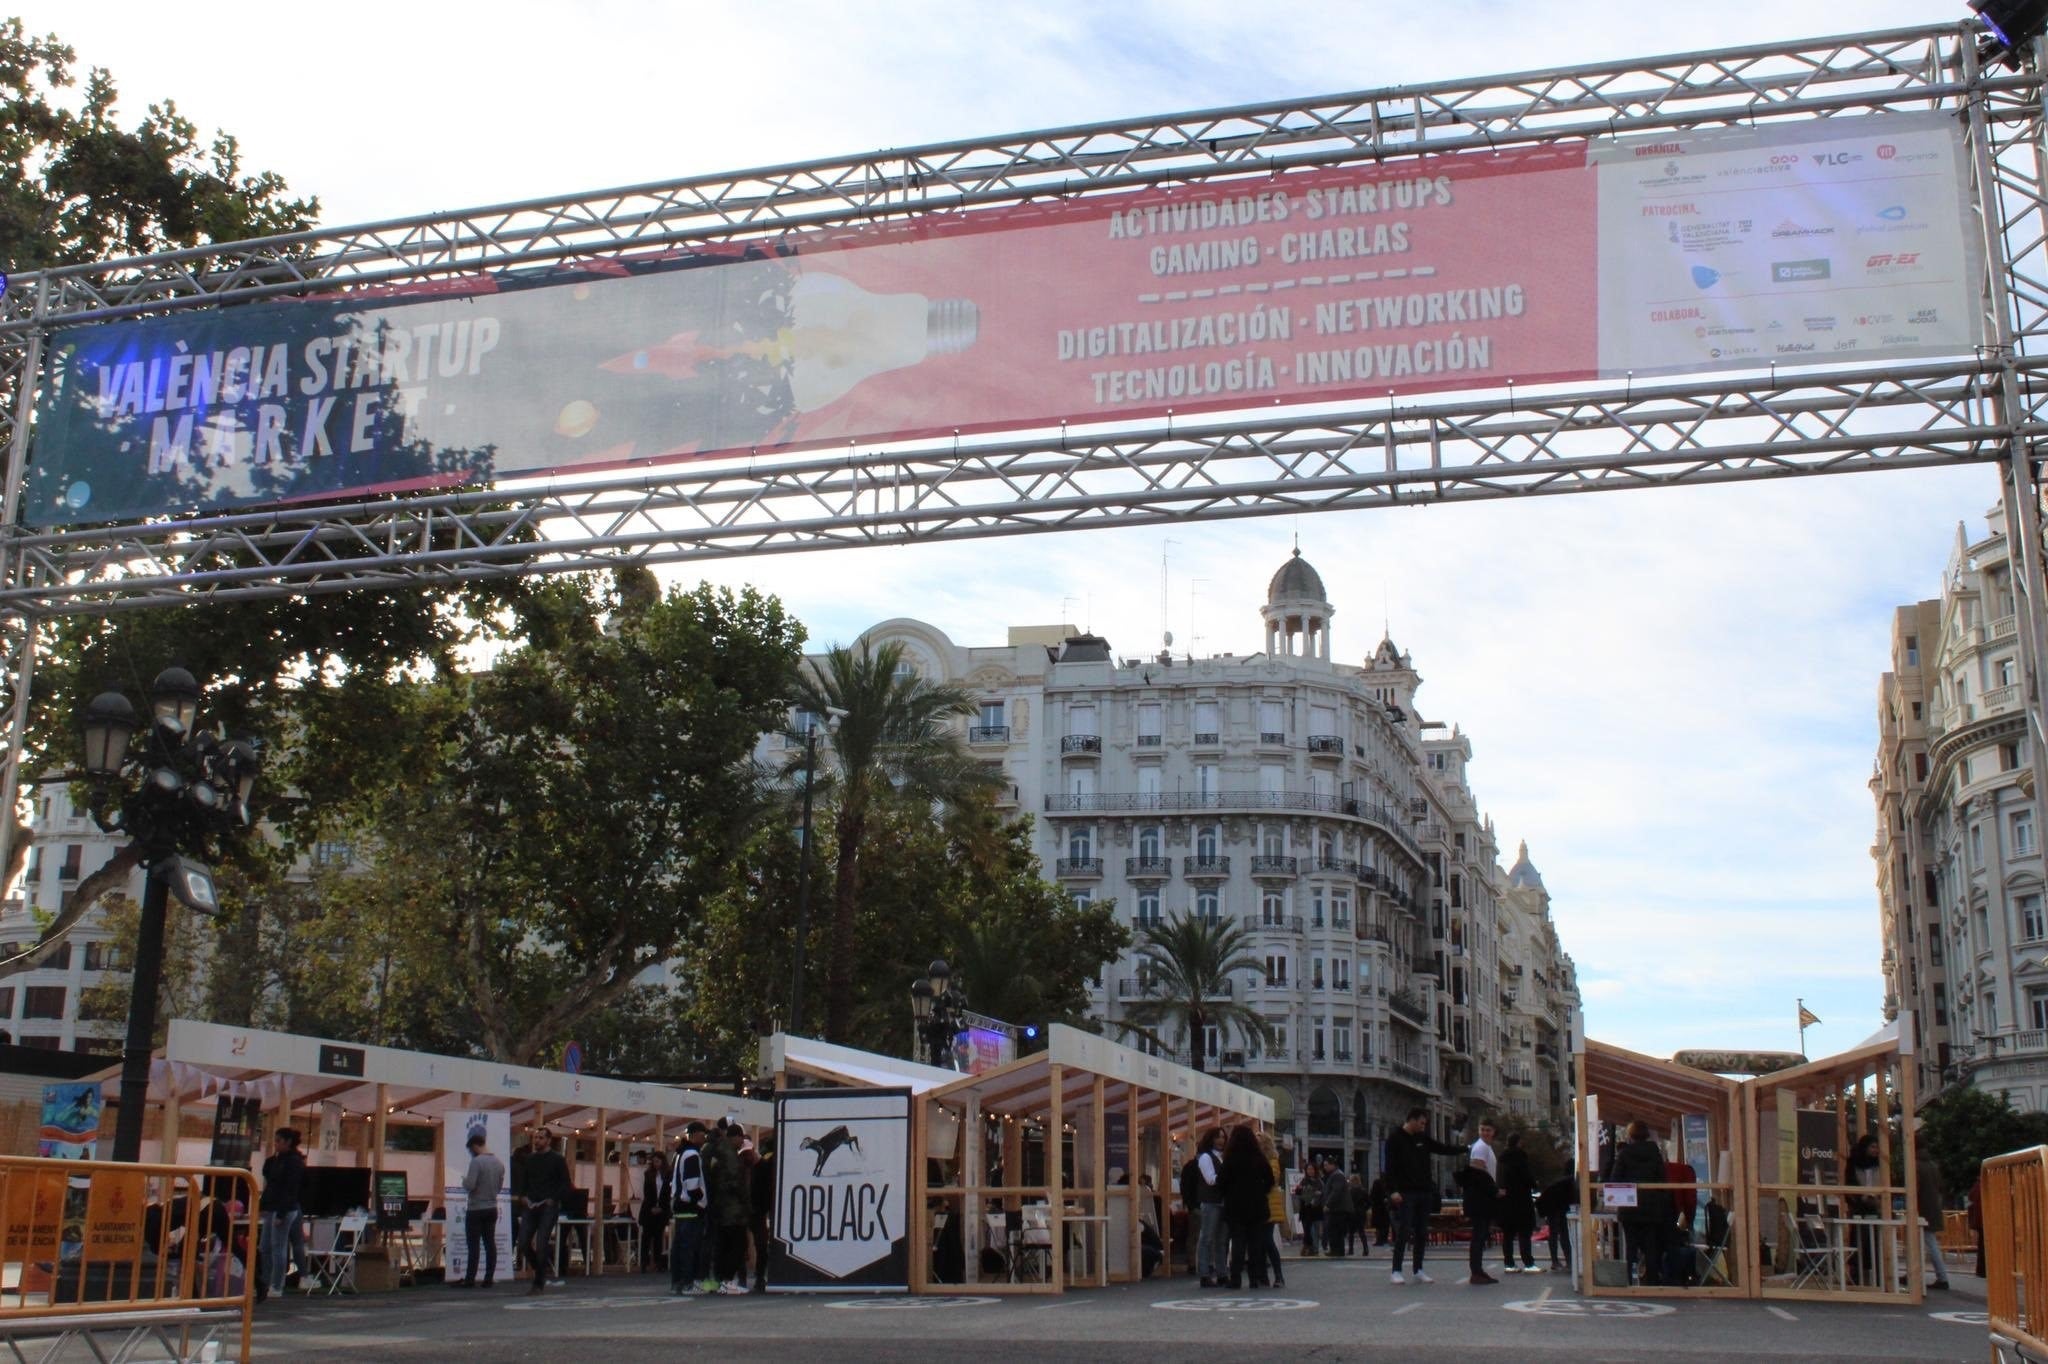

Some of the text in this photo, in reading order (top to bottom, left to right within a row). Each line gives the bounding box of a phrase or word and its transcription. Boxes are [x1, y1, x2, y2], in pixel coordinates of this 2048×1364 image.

[1108, 175, 1454, 240] ACTIVIDADES STARTUPS
[1149, 221, 1411, 277] GAMING CHARLAS
[1057, 284, 1525, 361] DIGITALIZACIÓN NETWORKING
[99, 315, 501, 419] VALÈNCIA STARTUP
[1091, 331, 1491, 404] TECNOLOGÍA INNOVACIÓN
[148, 386, 429, 476] MARKET
[788, 1182, 891, 1243] OBLACK
